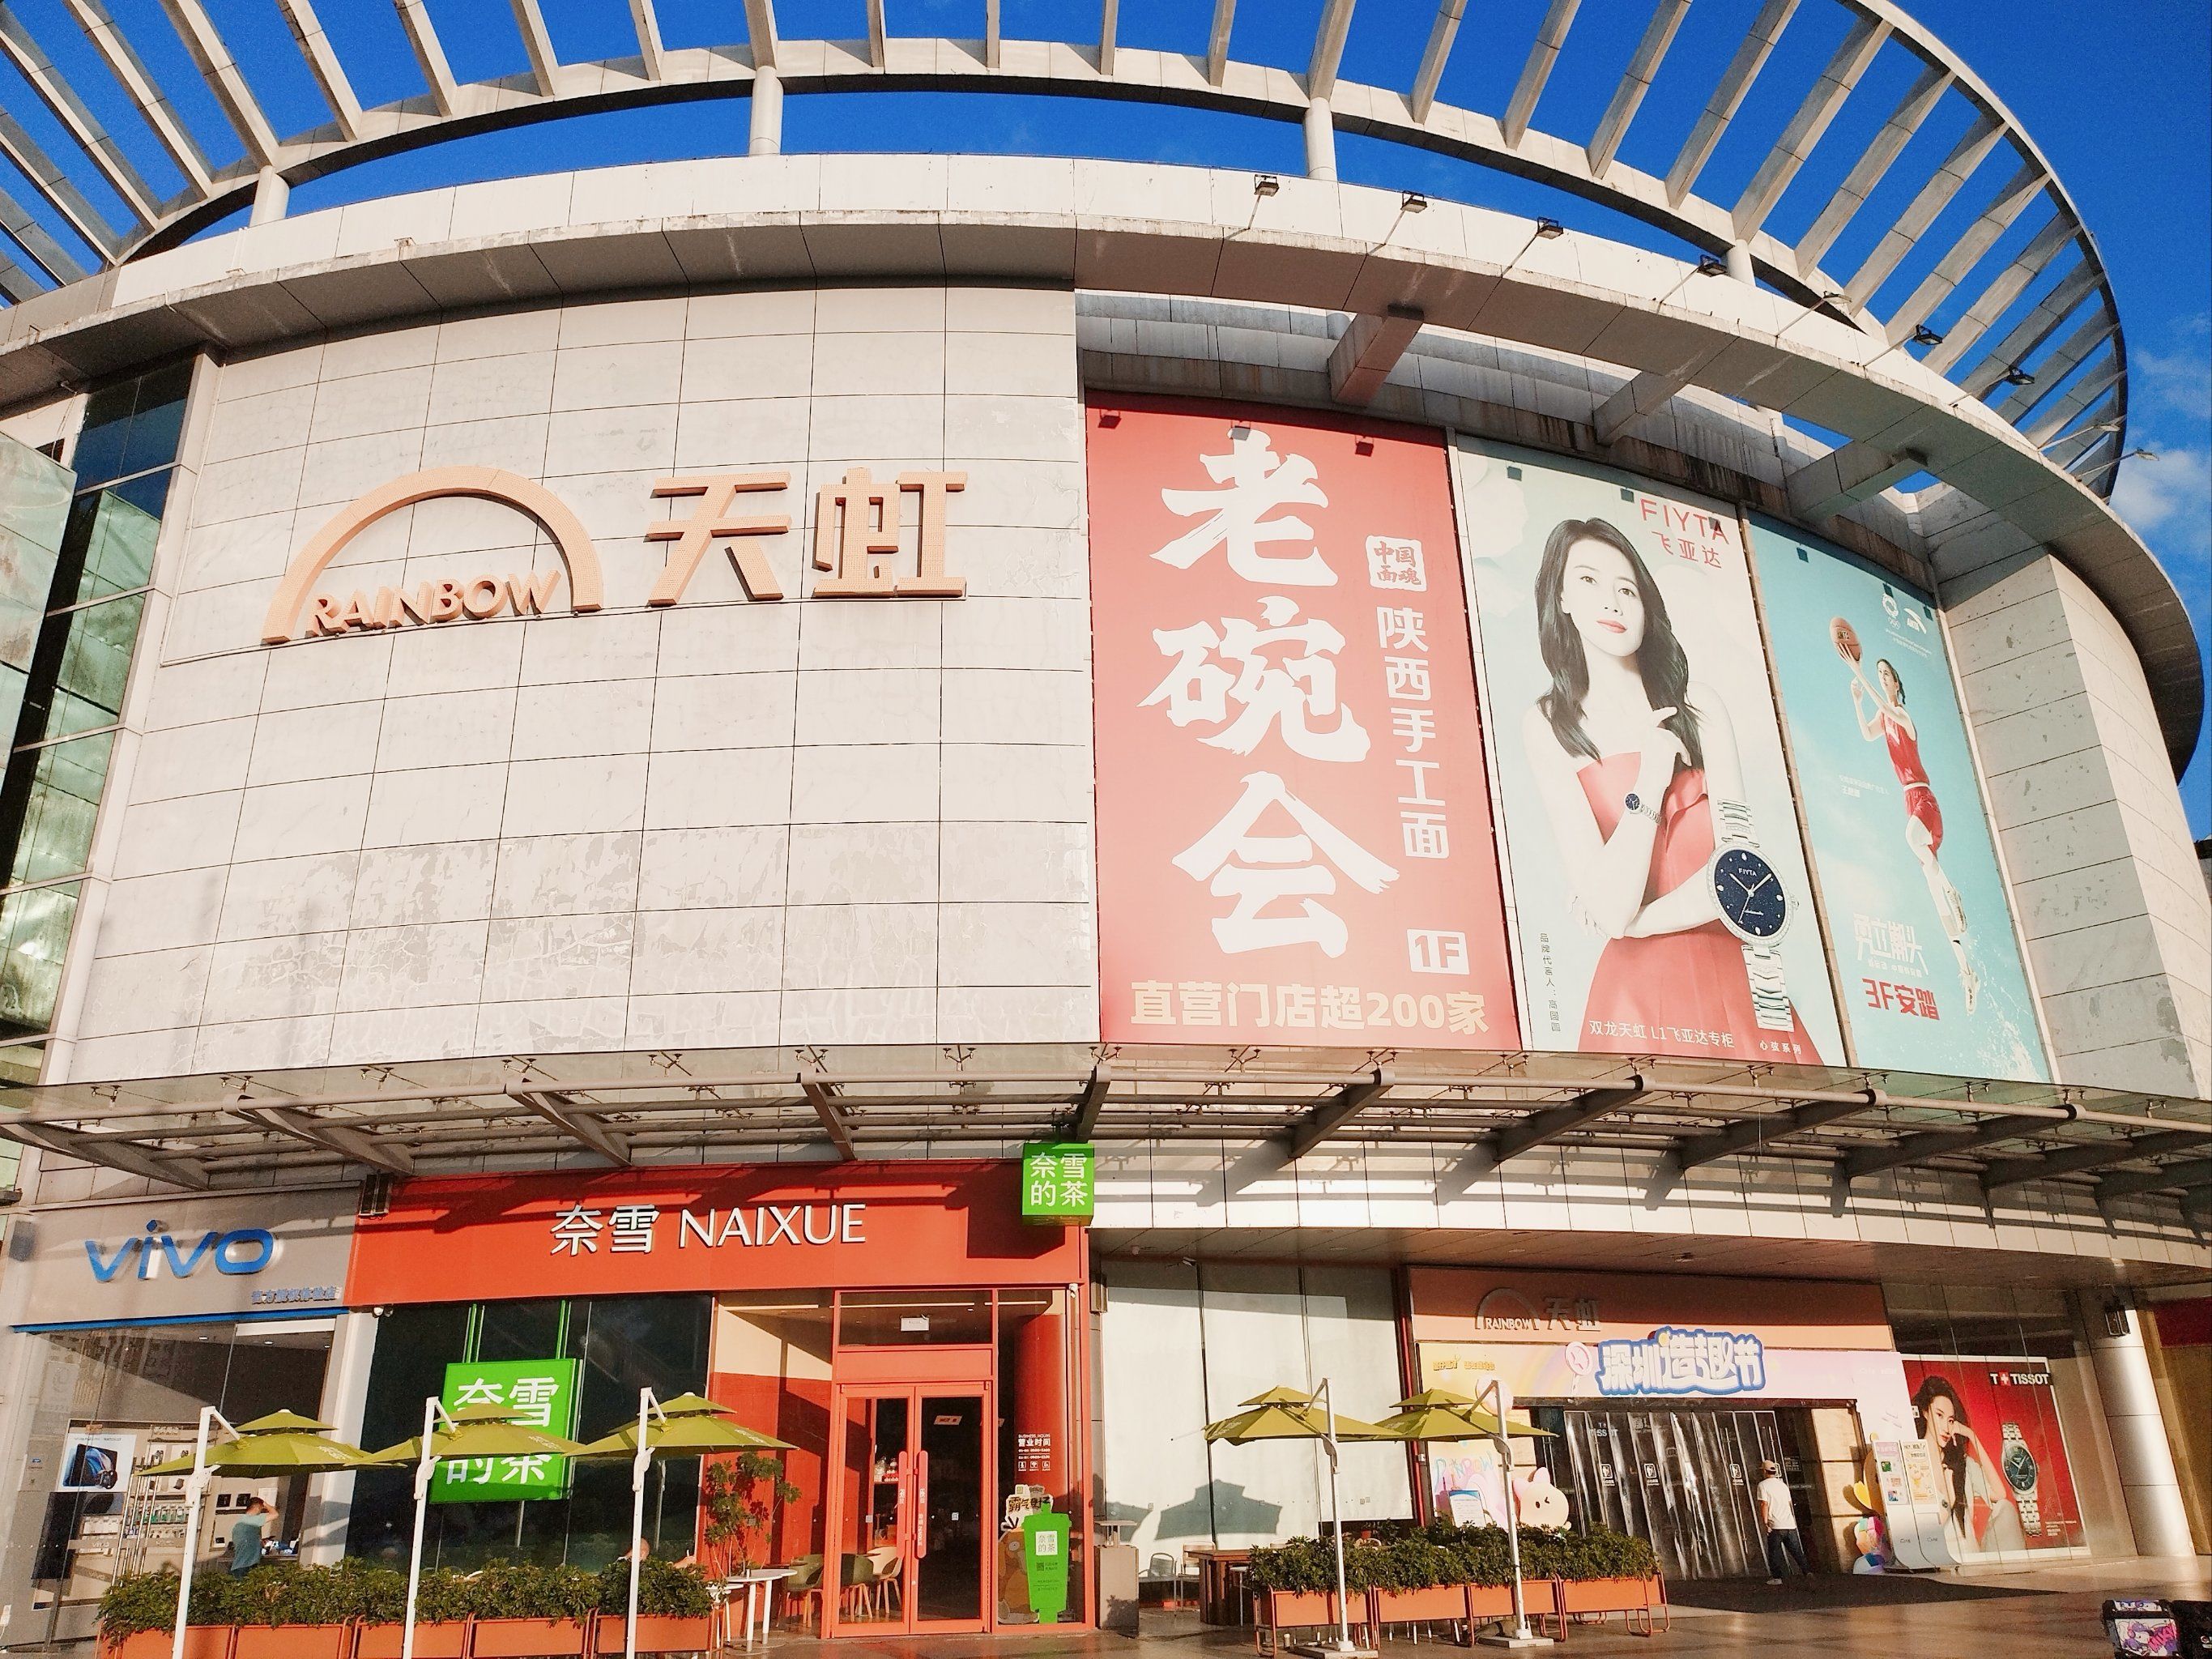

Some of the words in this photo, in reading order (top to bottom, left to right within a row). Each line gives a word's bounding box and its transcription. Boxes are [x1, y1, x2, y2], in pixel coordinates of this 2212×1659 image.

[646, 467, 968, 607] 天虹
[1640, 498, 1729, 544] FIYTA
[1374, 540, 1417, 566] 中国
[1652, 531, 1722, 569] 飞亚达
[1377, 565, 1421, 586] 面魂
[305, 569, 561, 638] RAINBOW
[1136, 427, 1400, 958] 老碗会
[1377, 606, 1450, 859] 陕西手工面
[1738, 868, 1757, 876] FIYTA
[1414, 935, 1461, 970] 1F
[1130, 979, 1490, 1036] 直营门店超200家
[1589, 1020, 1647, 1040] 双龙天虹
[1651, 1026, 1735, 1048] L1飞亚达专柜
[1759, 1039, 1802, 1056] 心弦系列
[1029, 1151, 1088, 1179] 奈雪
[1030, 1180, 1089, 1207] 的茶
[550, 1204, 660, 1256] 奈雪
[678, 1203, 867, 1247] NAIXUE
[84, 1219, 276, 1283] vivo
[1484, 1317, 1532, 1330] RAINBOW
[1544, 1297, 1601, 1332] 天虹
[2010, 1373, 2049, 1385] TISSOT
[1018, 1438, 1051, 1447] 营业时间
